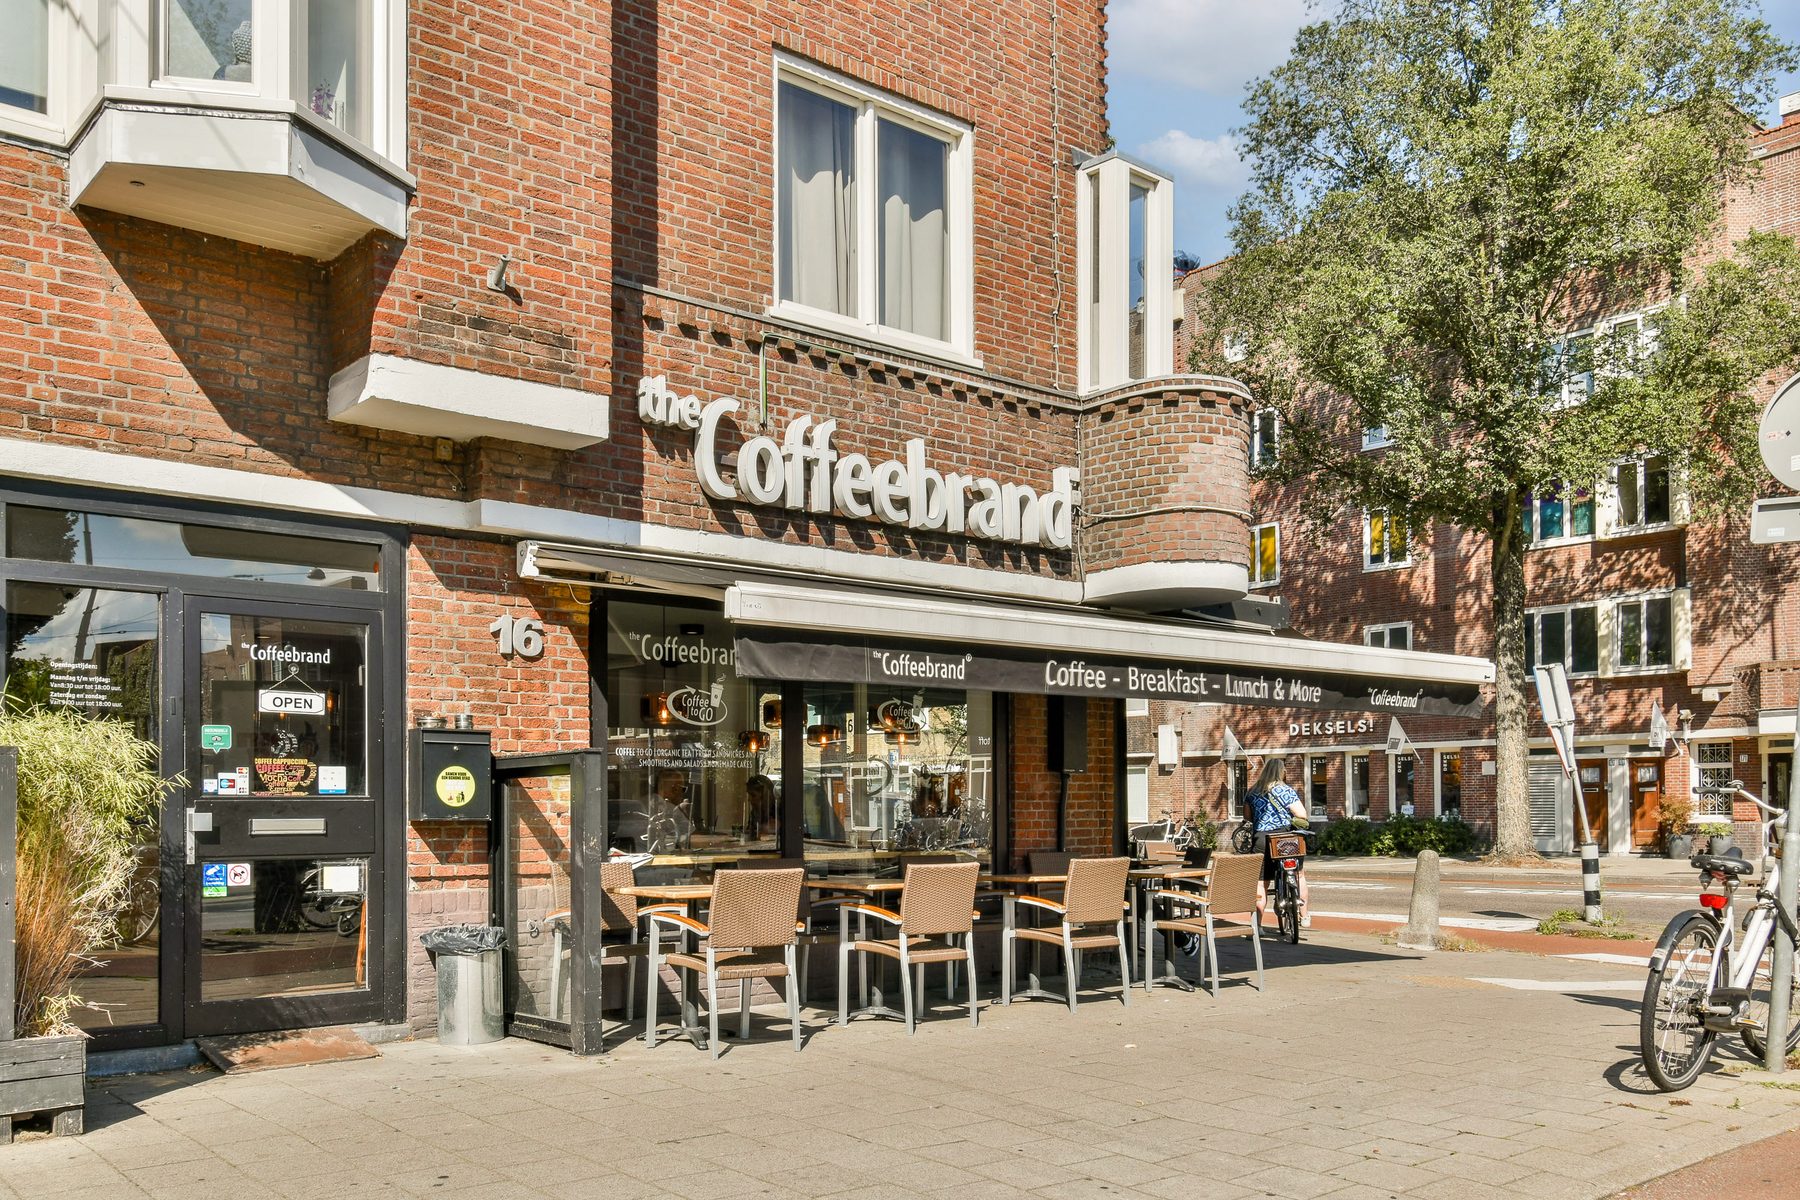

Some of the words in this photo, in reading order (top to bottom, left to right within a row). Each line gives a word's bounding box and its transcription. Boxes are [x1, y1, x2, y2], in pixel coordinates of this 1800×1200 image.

[638, 375, 700, 431] the
[694, 397, 1072, 550] Coffeebrand
[490, 614, 545, 657] 16
[250, 644, 331, 664] Coffeebrand
[629, 632, 640, 641] the
[641, 634, 737, 666] Coffeebran
[873, 651, 882, 659] the
[50, 661, 98, 669] Openingstijden:
[50, 674, 76, 682] Maandag
[1045, 660, 1107, 688] Coffee
[1128, 666, 1209, 695] Breakfast
[1225, 673, 1268, 699] Lunch
[1273, 677, 1285, 700] &
[1290, 679, 1322, 703] More
[50, 691, 76, 699] Zaterdag
[682, 695, 709, 707] Coffee
[272, 696, 313, 709] OPEN
[691, 707, 699, 716] to
[699, 707, 713, 721] GO
[890, 705, 912, 717] Coffee
[1289, 719, 1375, 737] DEKSELS!
[615, 747, 636, 757] COFFEE
[636, 748, 645, 757] TO
[645, 748, 653, 757] GO
[656, 748, 681, 757] ORGANIC
[682, 748, 693, 758] TEA
[639, 759, 671, 768] SMOOTHIES
[671, 759, 682, 768] AND
[683, 760, 703, 768] SALADS
[736, 761, 753, 769] CAKES
